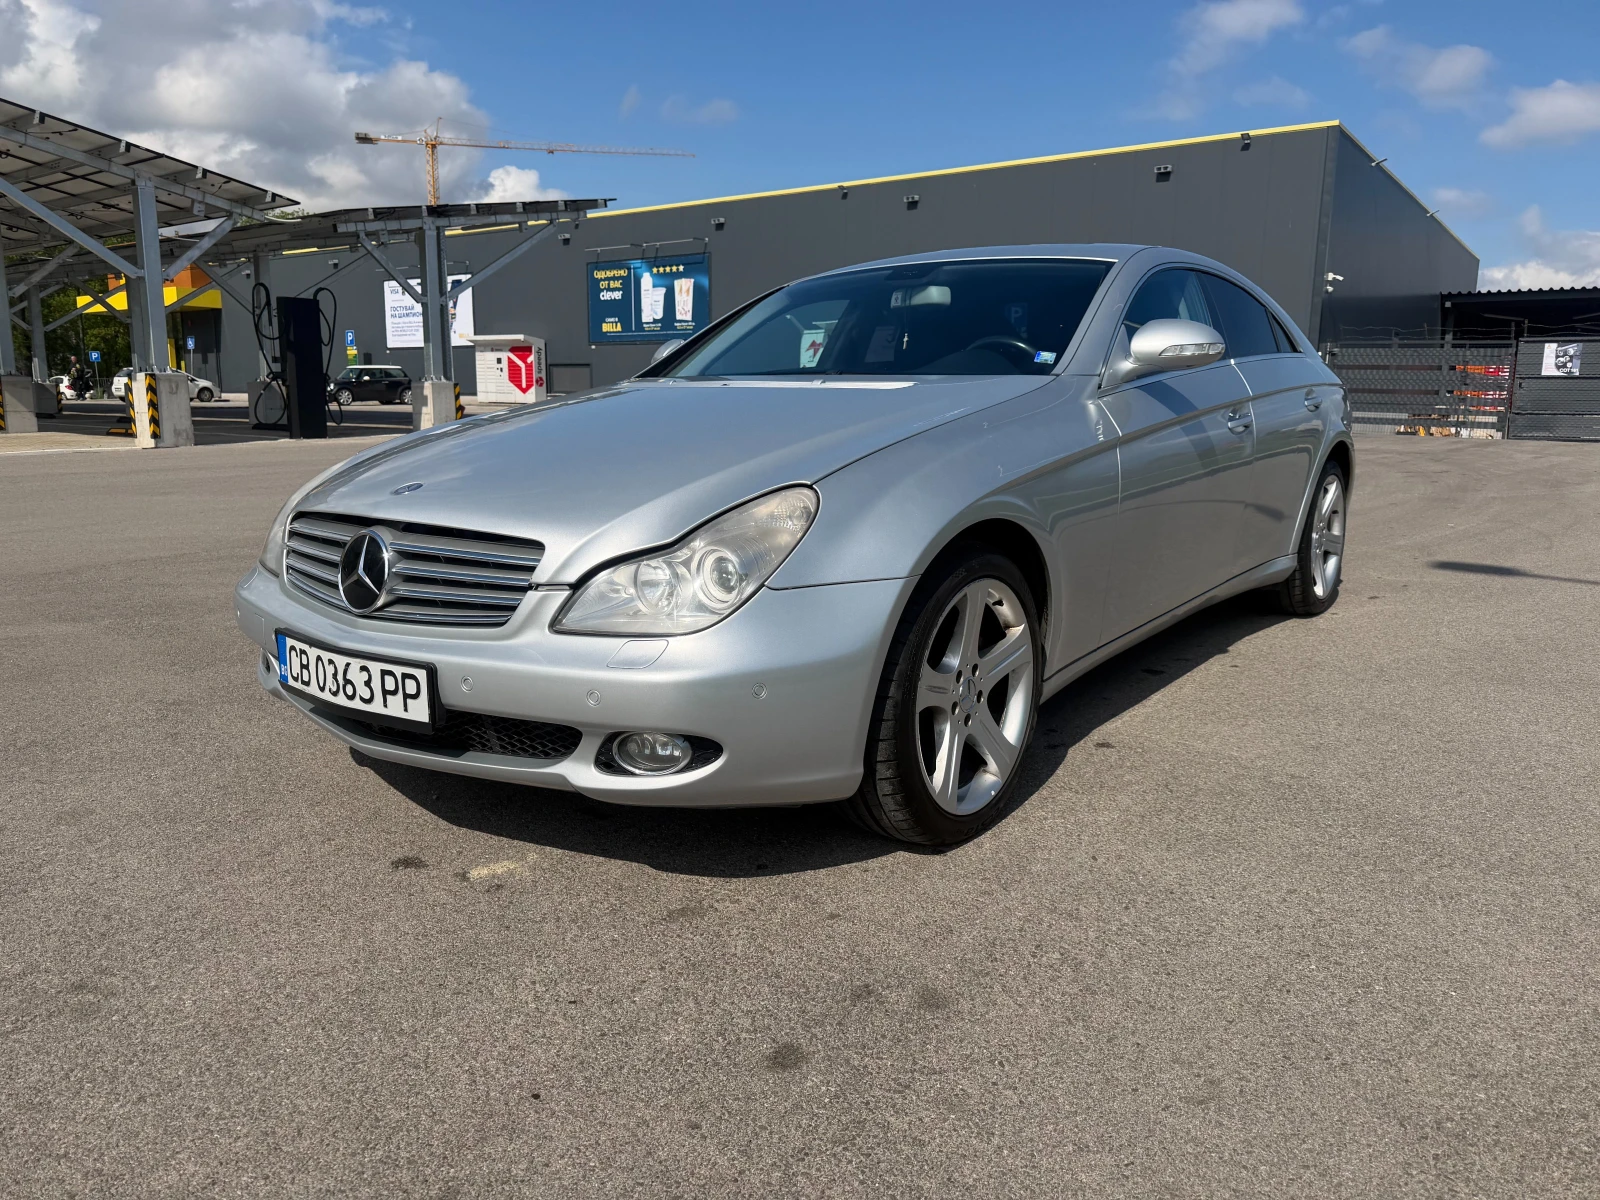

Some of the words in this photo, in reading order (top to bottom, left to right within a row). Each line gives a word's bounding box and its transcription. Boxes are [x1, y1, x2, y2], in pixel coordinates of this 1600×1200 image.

[594, 269, 627, 279] ОДОБРЕНО
[610, 280, 623, 288] ВАС
[600, 290, 623, 300] clever
[390, 304, 415, 312] ГОСТУВАЙ
[602, 322, 622, 332] BILLA
[347, 332, 353, 344] P
[91, 352, 98, 361] P
